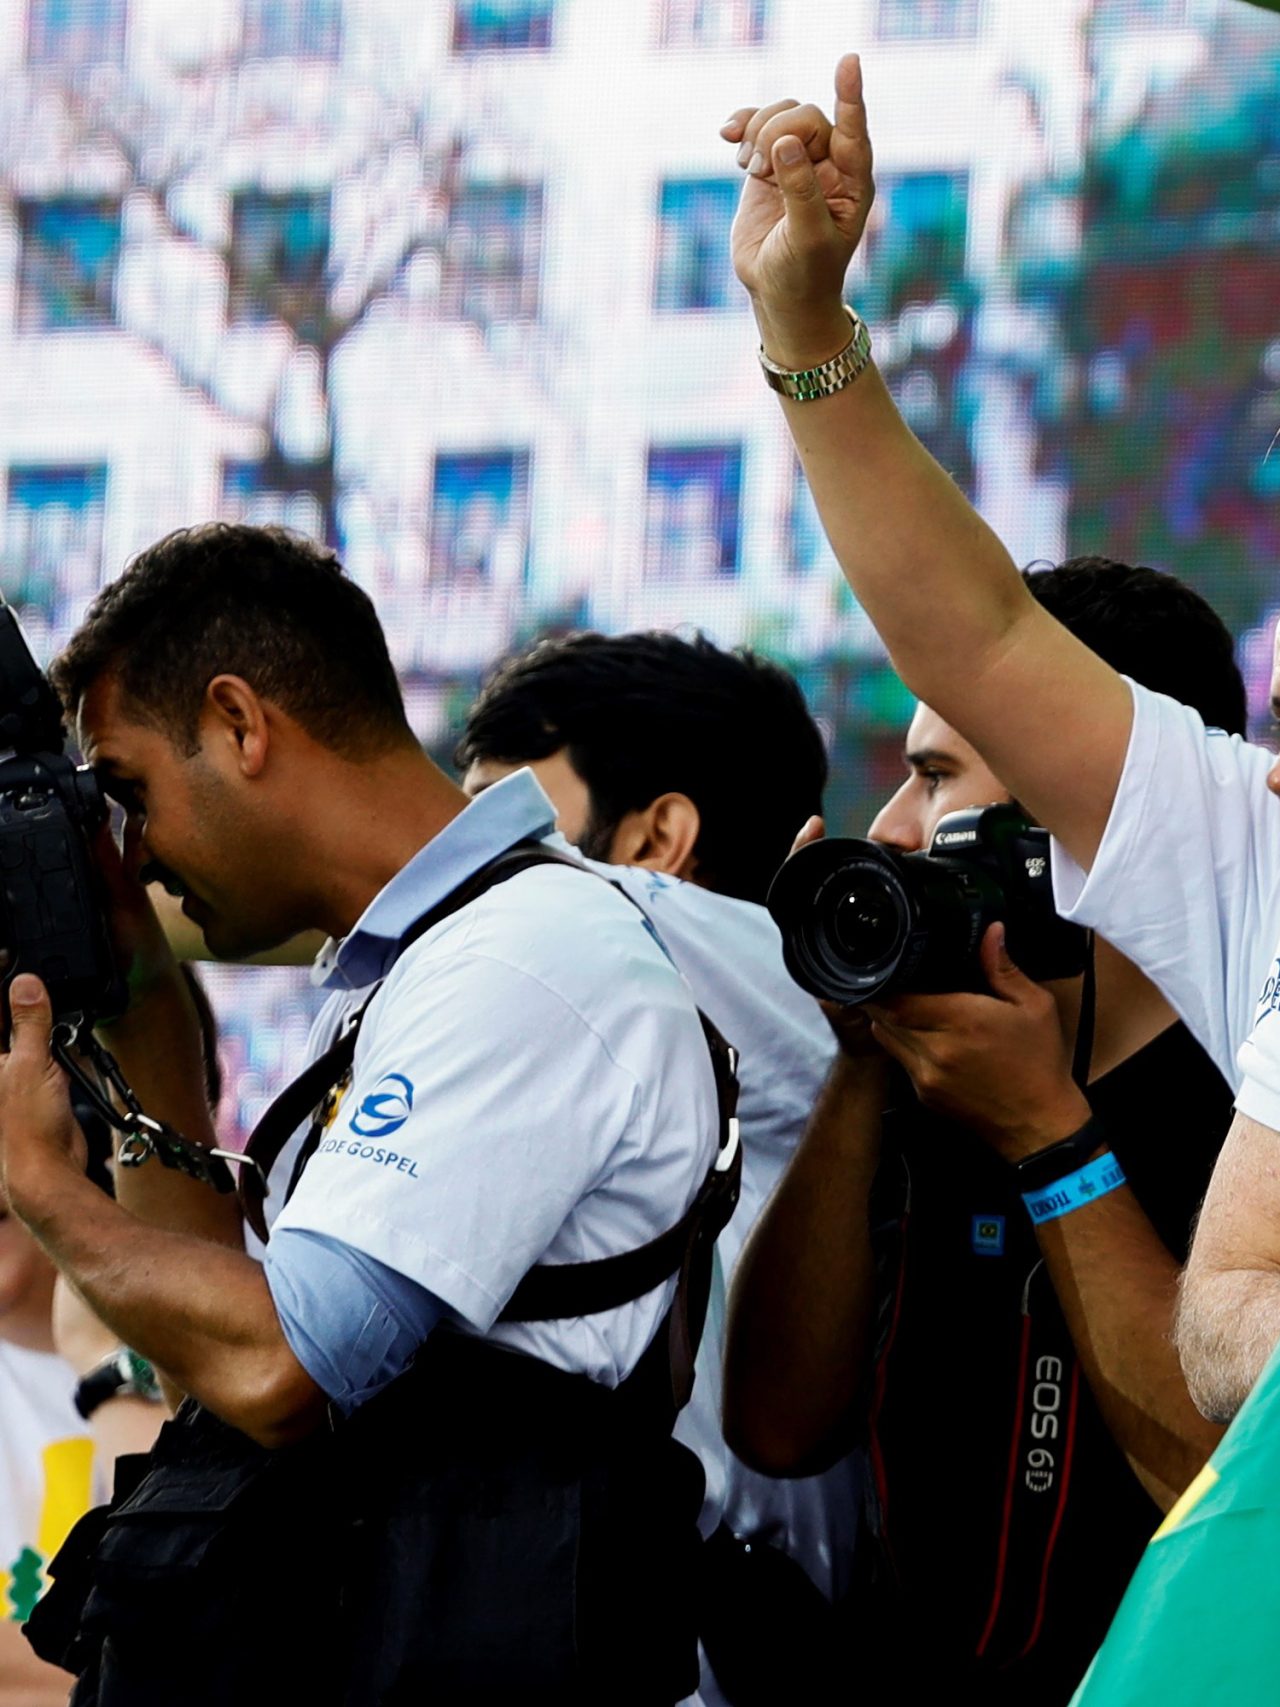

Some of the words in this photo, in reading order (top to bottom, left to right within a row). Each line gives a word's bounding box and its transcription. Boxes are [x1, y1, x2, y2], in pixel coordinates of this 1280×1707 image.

[935, 830, 977, 845] Canon
[1025, 857, 1046, 869] EOS
[347, 1141, 418, 1178] GOSPEL
[1031, 1355, 1062, 1439] EOS
[1026, 1448, 1054, 1492] 6D
